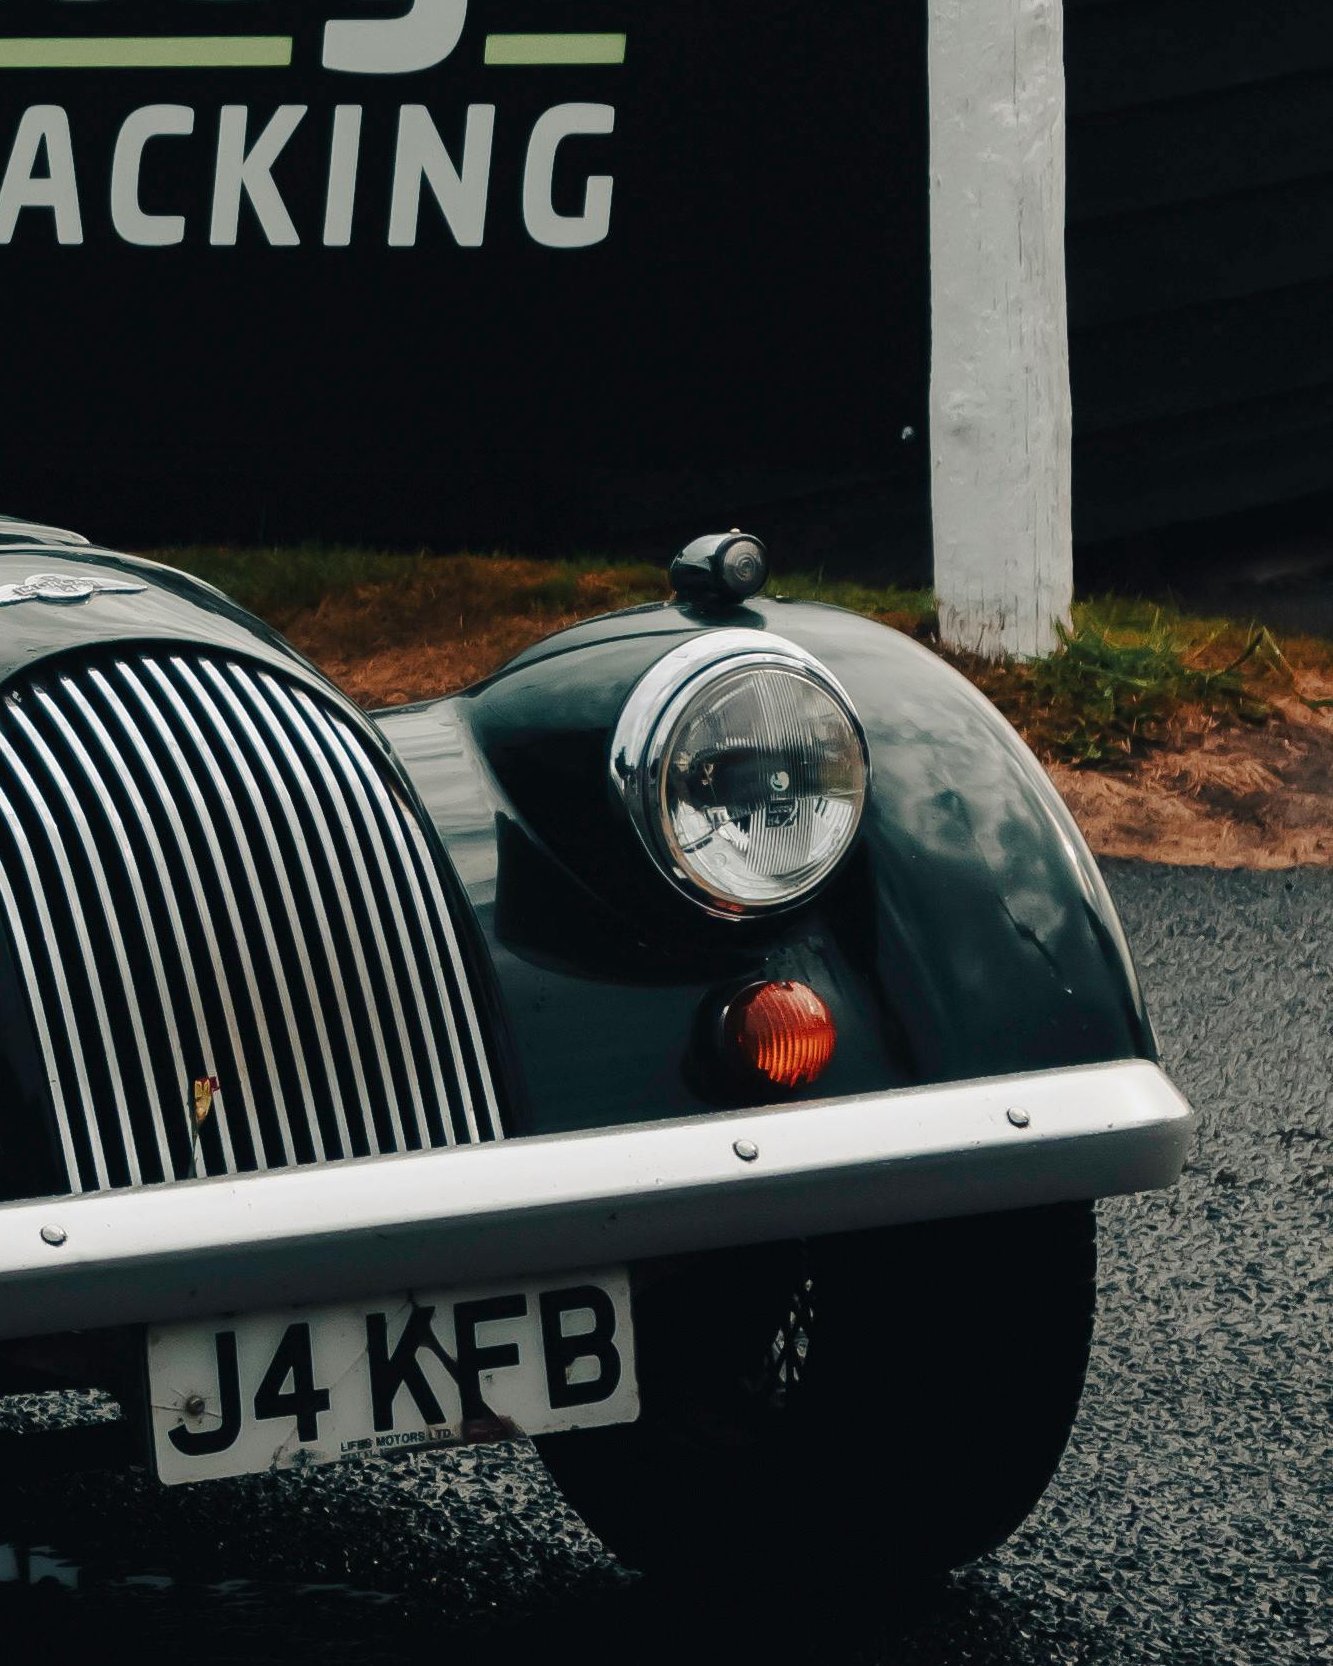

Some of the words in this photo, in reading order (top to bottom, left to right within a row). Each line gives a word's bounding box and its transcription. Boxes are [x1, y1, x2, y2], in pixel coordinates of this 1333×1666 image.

[168, 1323, 331, 1457] J4
[366, 1285, 621, 1432] KFB
[376, 1431, 426, 1447] MOTORS
